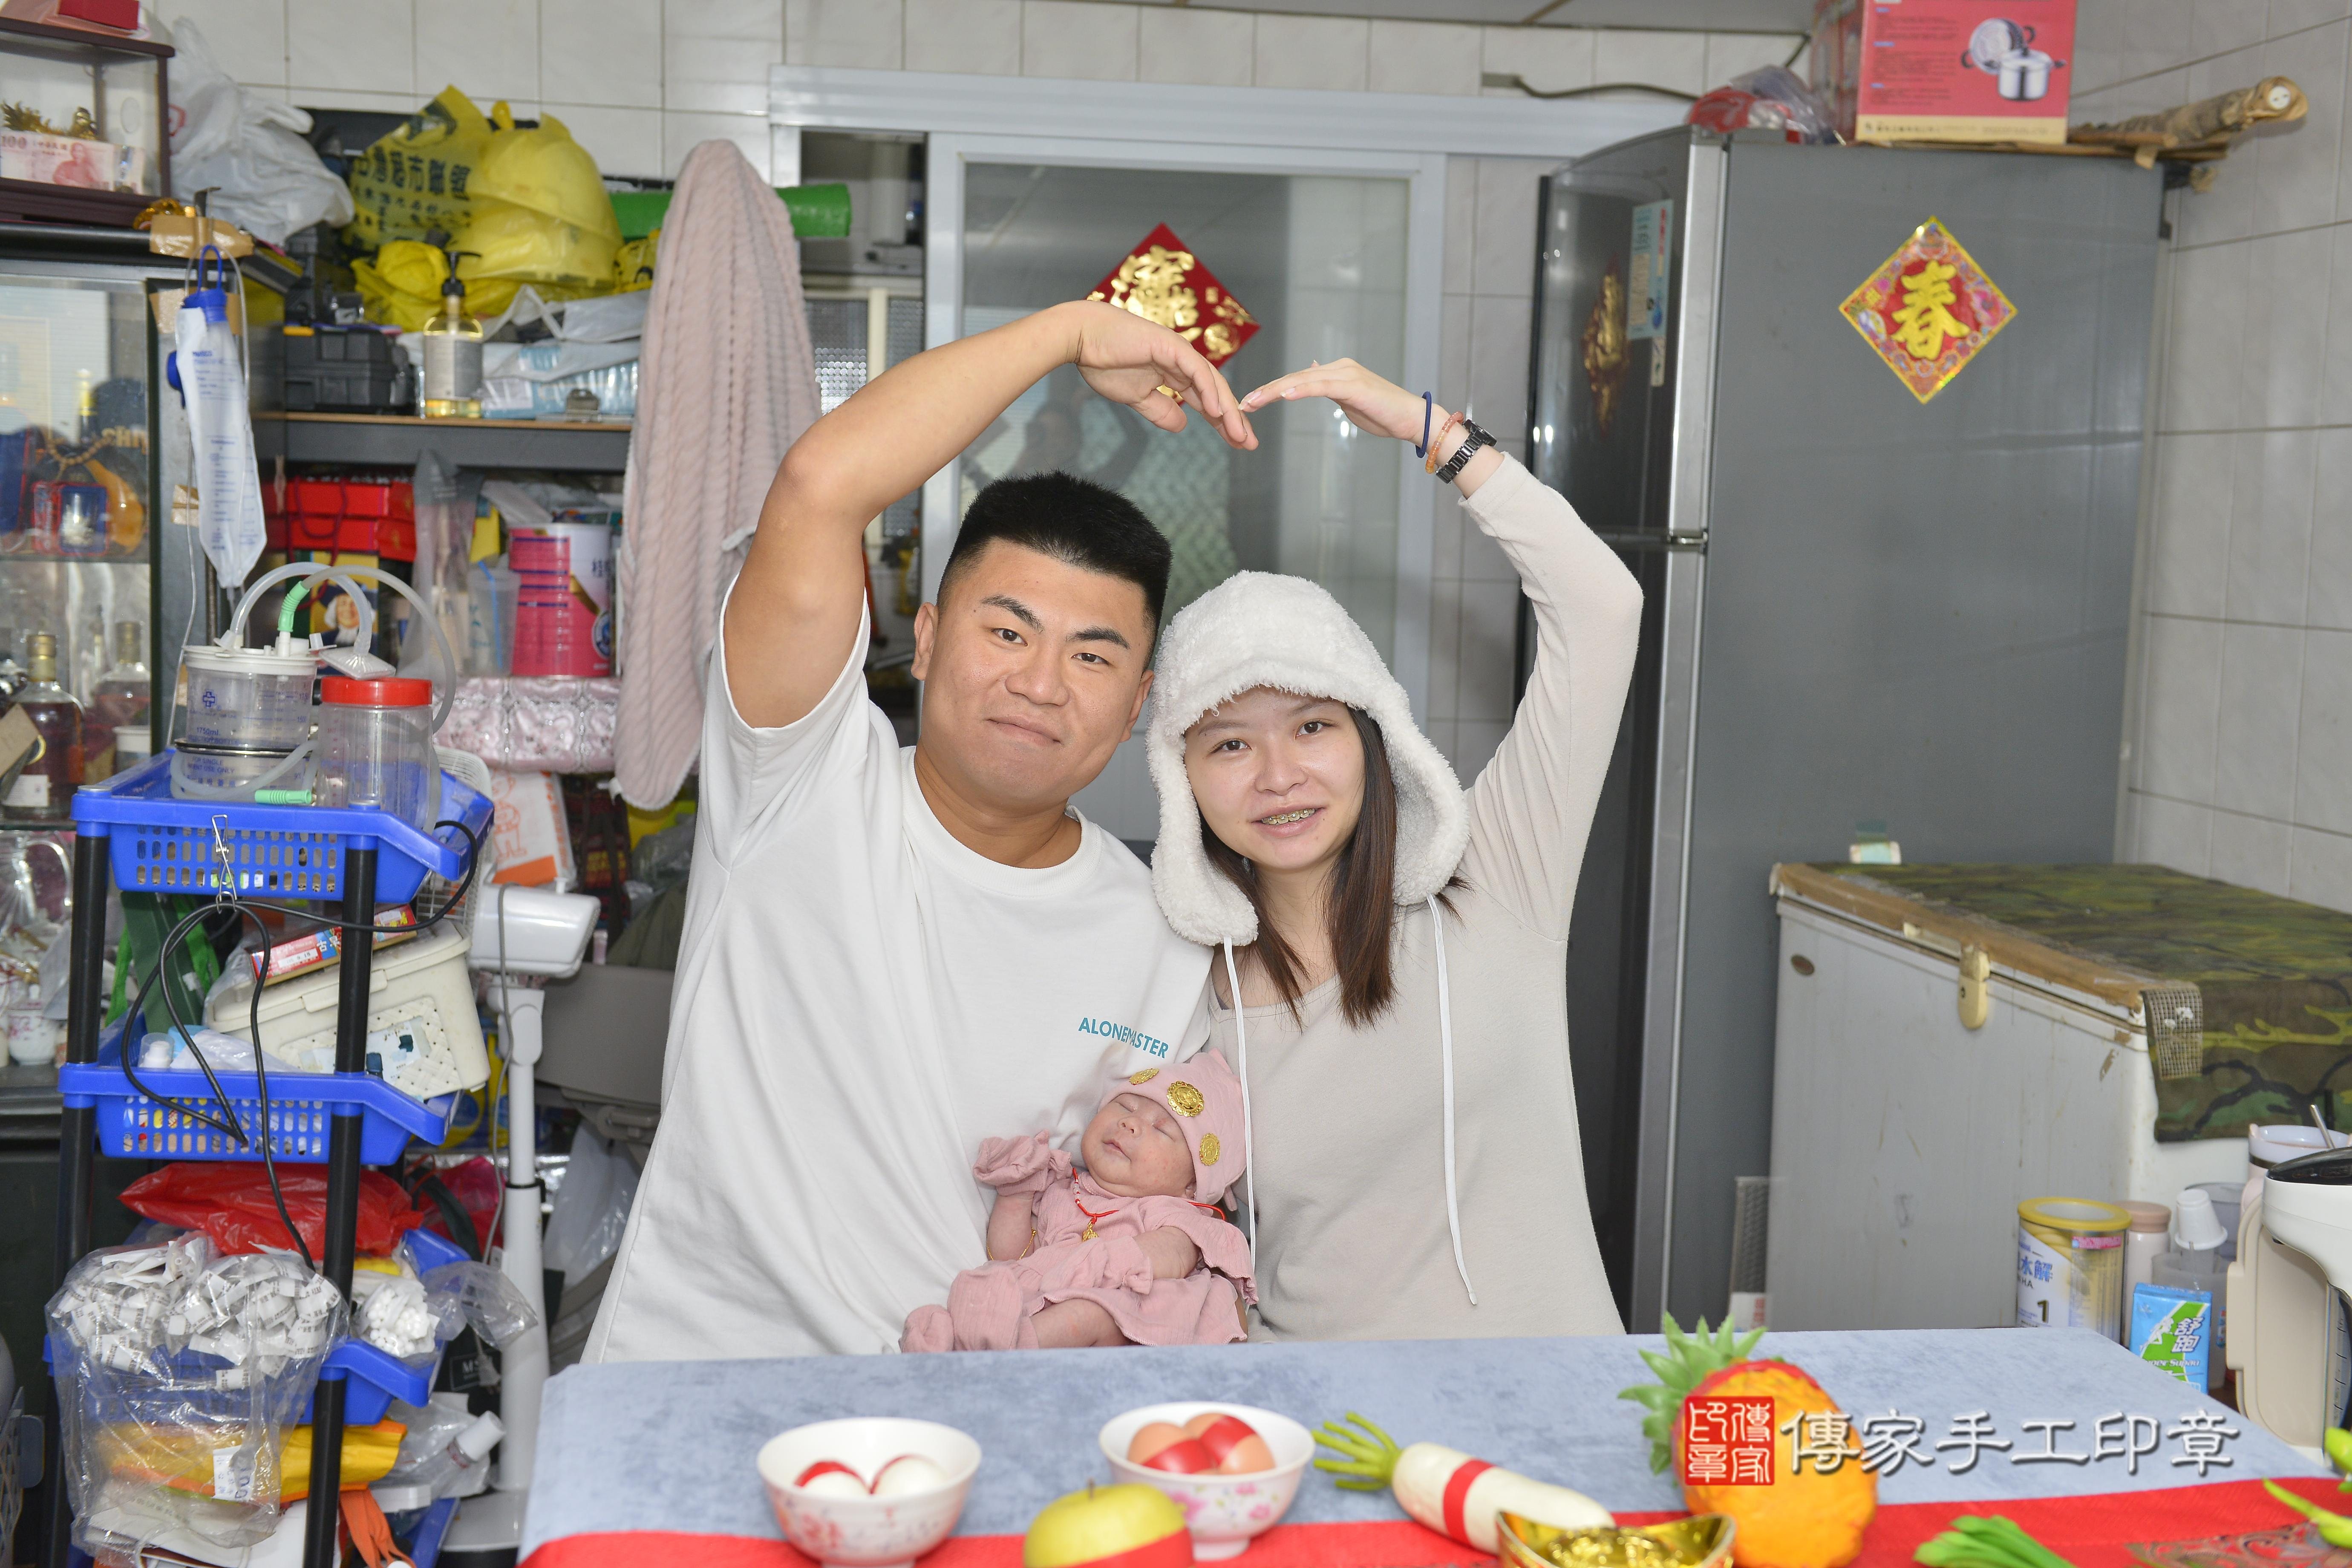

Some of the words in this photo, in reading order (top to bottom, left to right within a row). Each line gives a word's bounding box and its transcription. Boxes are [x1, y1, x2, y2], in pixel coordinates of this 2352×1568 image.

[1, 136, 26, 149] 100
[1890, 259, 1971, 361] 春
[1078, 1017, 1169, 1059] ALONEMASTER
[2019, 1256, 2053, 1283] 水解
[2038, 1300, 2049, 1323] 1
[2169, 1316, 2205, 1353] 舒跑
